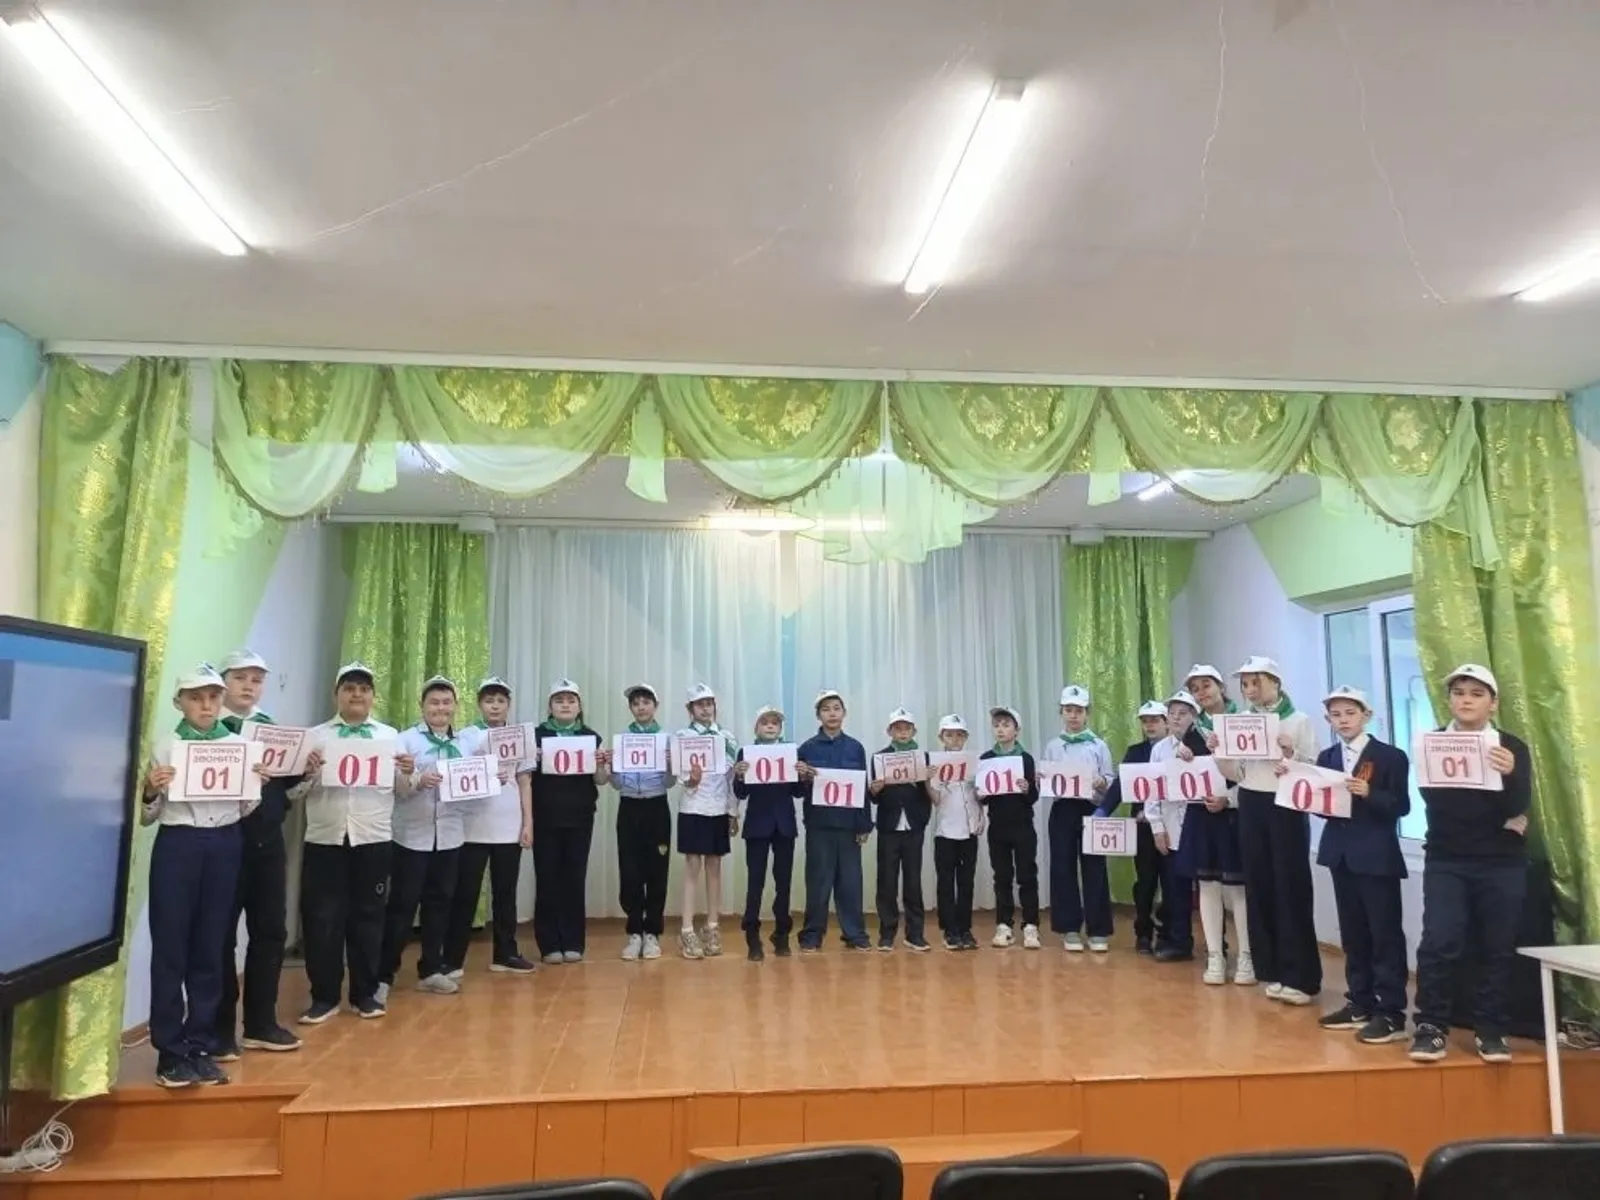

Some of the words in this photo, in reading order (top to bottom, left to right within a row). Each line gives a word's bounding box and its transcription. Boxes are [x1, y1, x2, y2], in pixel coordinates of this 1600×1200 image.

[499, 743, 517, 758] 01
[1236, 733, 1257, 751] 01
[262, 747, 287, 768] 01
[554, 749, 585, 774] 01
[631, 750, 648, 765] 01
[689, 752, 706, 768] 01
[1442, 756, 1469, 778] 01
[202, 767, 230, 790] 01
[338, 753, 379, 786] 01
[756, 757, 786, 783] 01
[893, 767, 909, 780] 01
[939, 762, 967, 783] 01
[460, 774, 479, 792] 01
[985, 768, 1014, 794] 01
[1051, 773, 1080, 797] 01
[1133, 775, 1167, 801] 01
[1180, 769, 1213, 799] 01
[824, 780, 854, 807] 01
[1292, 778, 1333, 815] 01
[1101, 833, 1118, 849] 01
